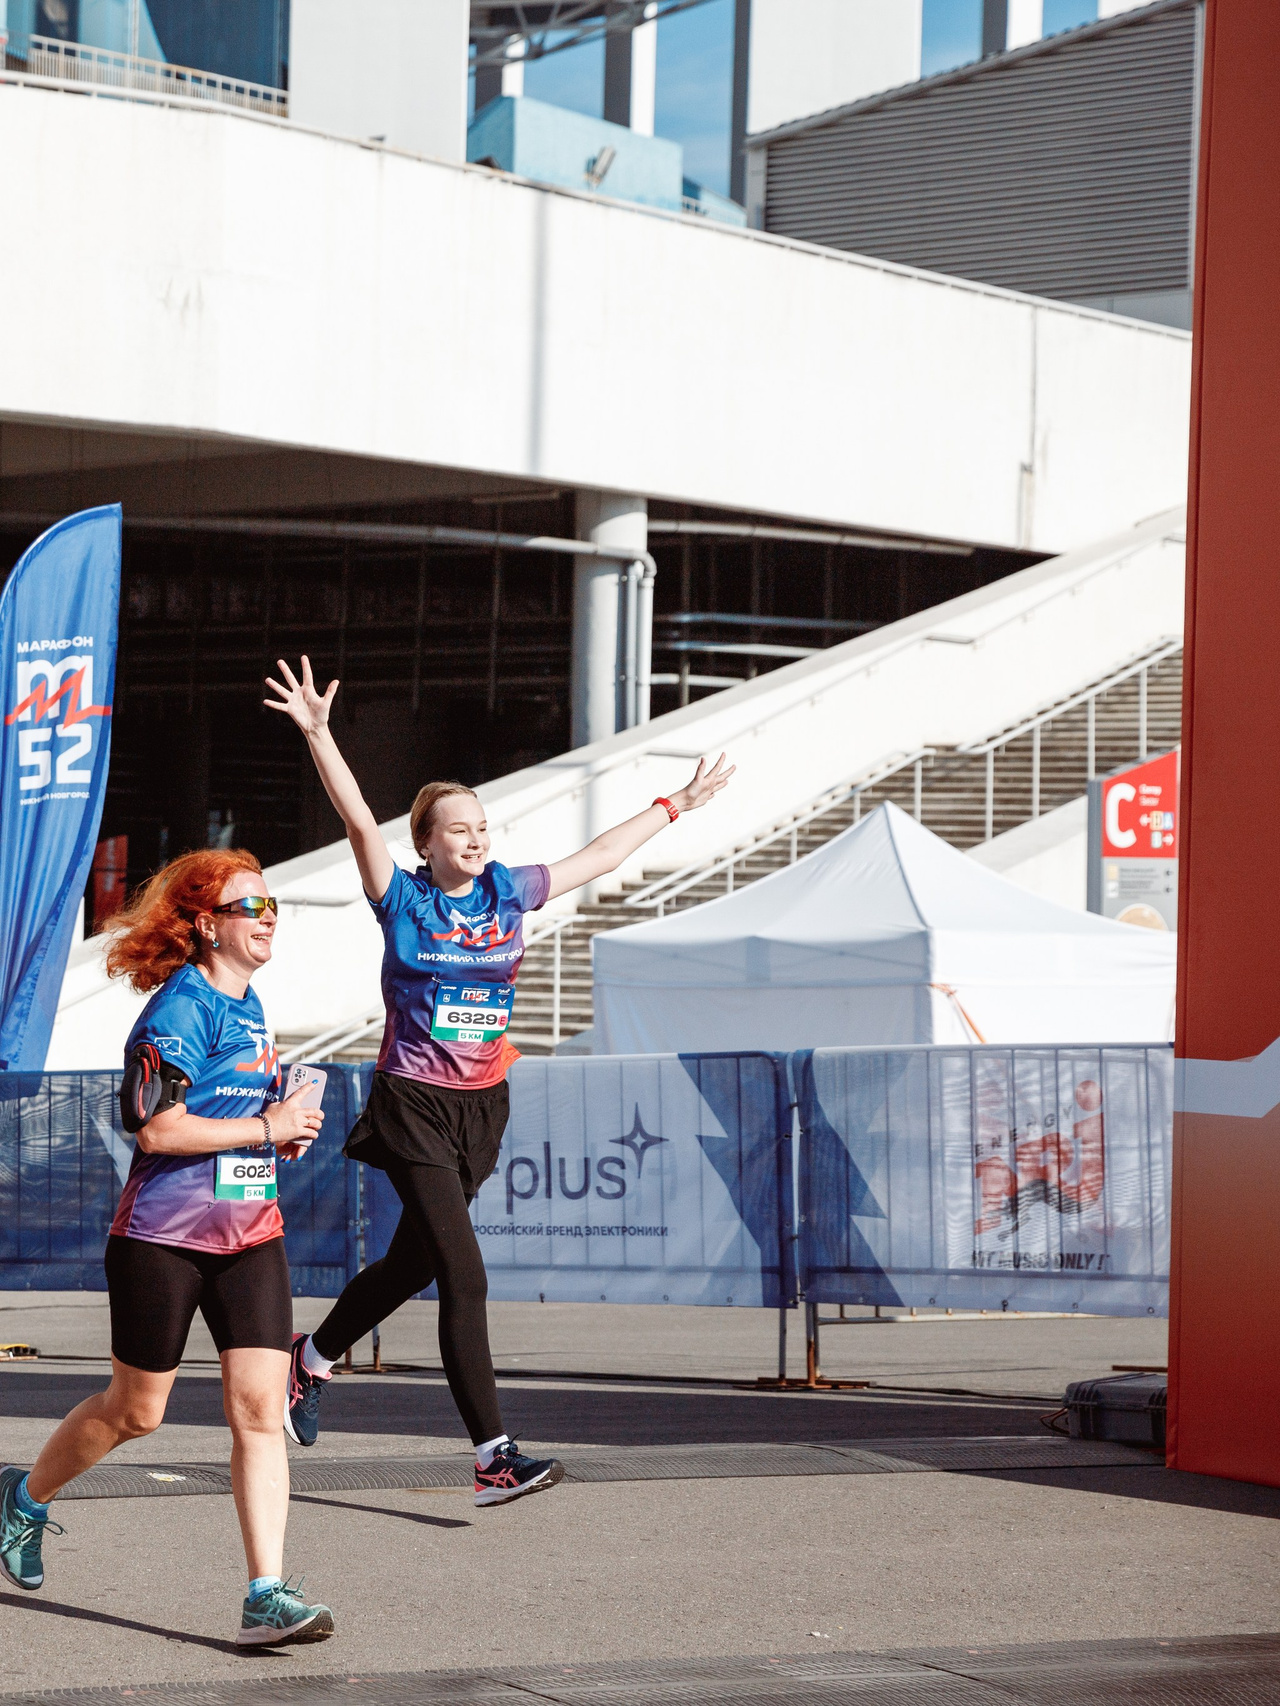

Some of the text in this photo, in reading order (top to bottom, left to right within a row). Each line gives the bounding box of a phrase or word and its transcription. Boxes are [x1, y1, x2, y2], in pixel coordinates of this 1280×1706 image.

[17, 636, 94, 653] МАРАФОН
[19, 723, 93, 790] 52
[1106, 783, 1137, 848] C
[417, 953, 475, 963] НИЖНИЙ
[447, 1012, 498, 1025] 6329
[233, 1165, 271, 1178] 6023
[473, 1141, 627, 1215] plus
[474, 1222, 668, 1237] РОССИЙСКИЙ БРЕНД ЭЛЕКТРОНИКИ
[1055, 1252, 1095, 1270] ONLY
